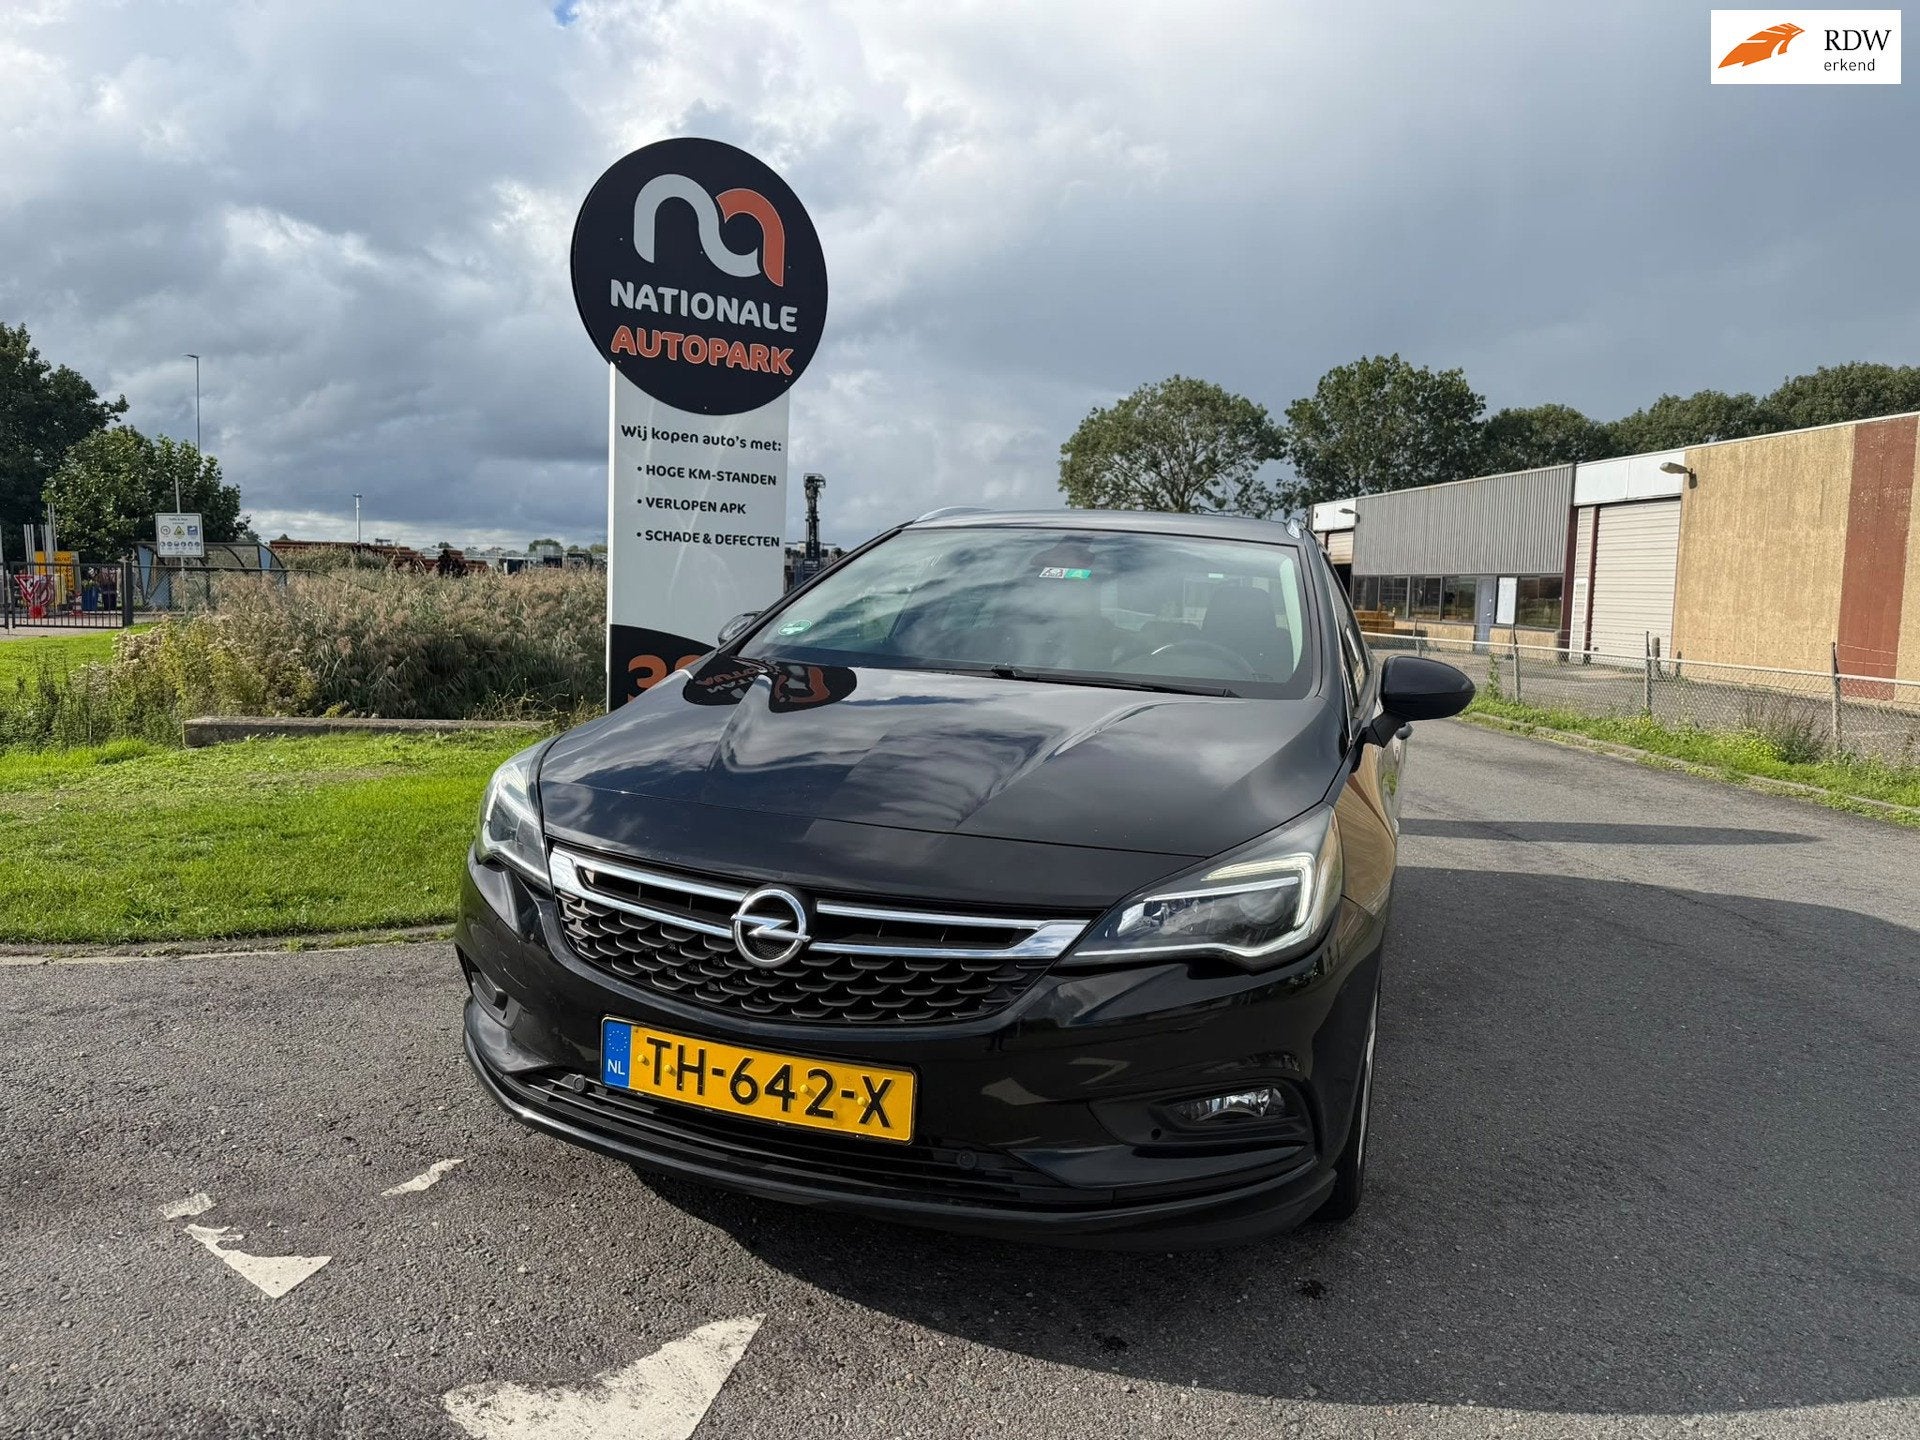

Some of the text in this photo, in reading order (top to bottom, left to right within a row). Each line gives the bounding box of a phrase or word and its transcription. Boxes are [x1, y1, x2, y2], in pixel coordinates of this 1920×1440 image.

[610, 278, 798, 333] NATIONALE
[610, 325, 794, 376] AUTOPARK
[621, 424, 782, 452] Wij kopen auto's met:
[646, 464, 777, 486] HOGE KM-STANDEN
[645, 496, 746, 515] VERLOPEN APK
[645, 529, 780, 548] SCHADE & DEFECTEN
[607, 1059, 626, 1076] NL
[646, 1036, 894, 1129] TH-642-X
